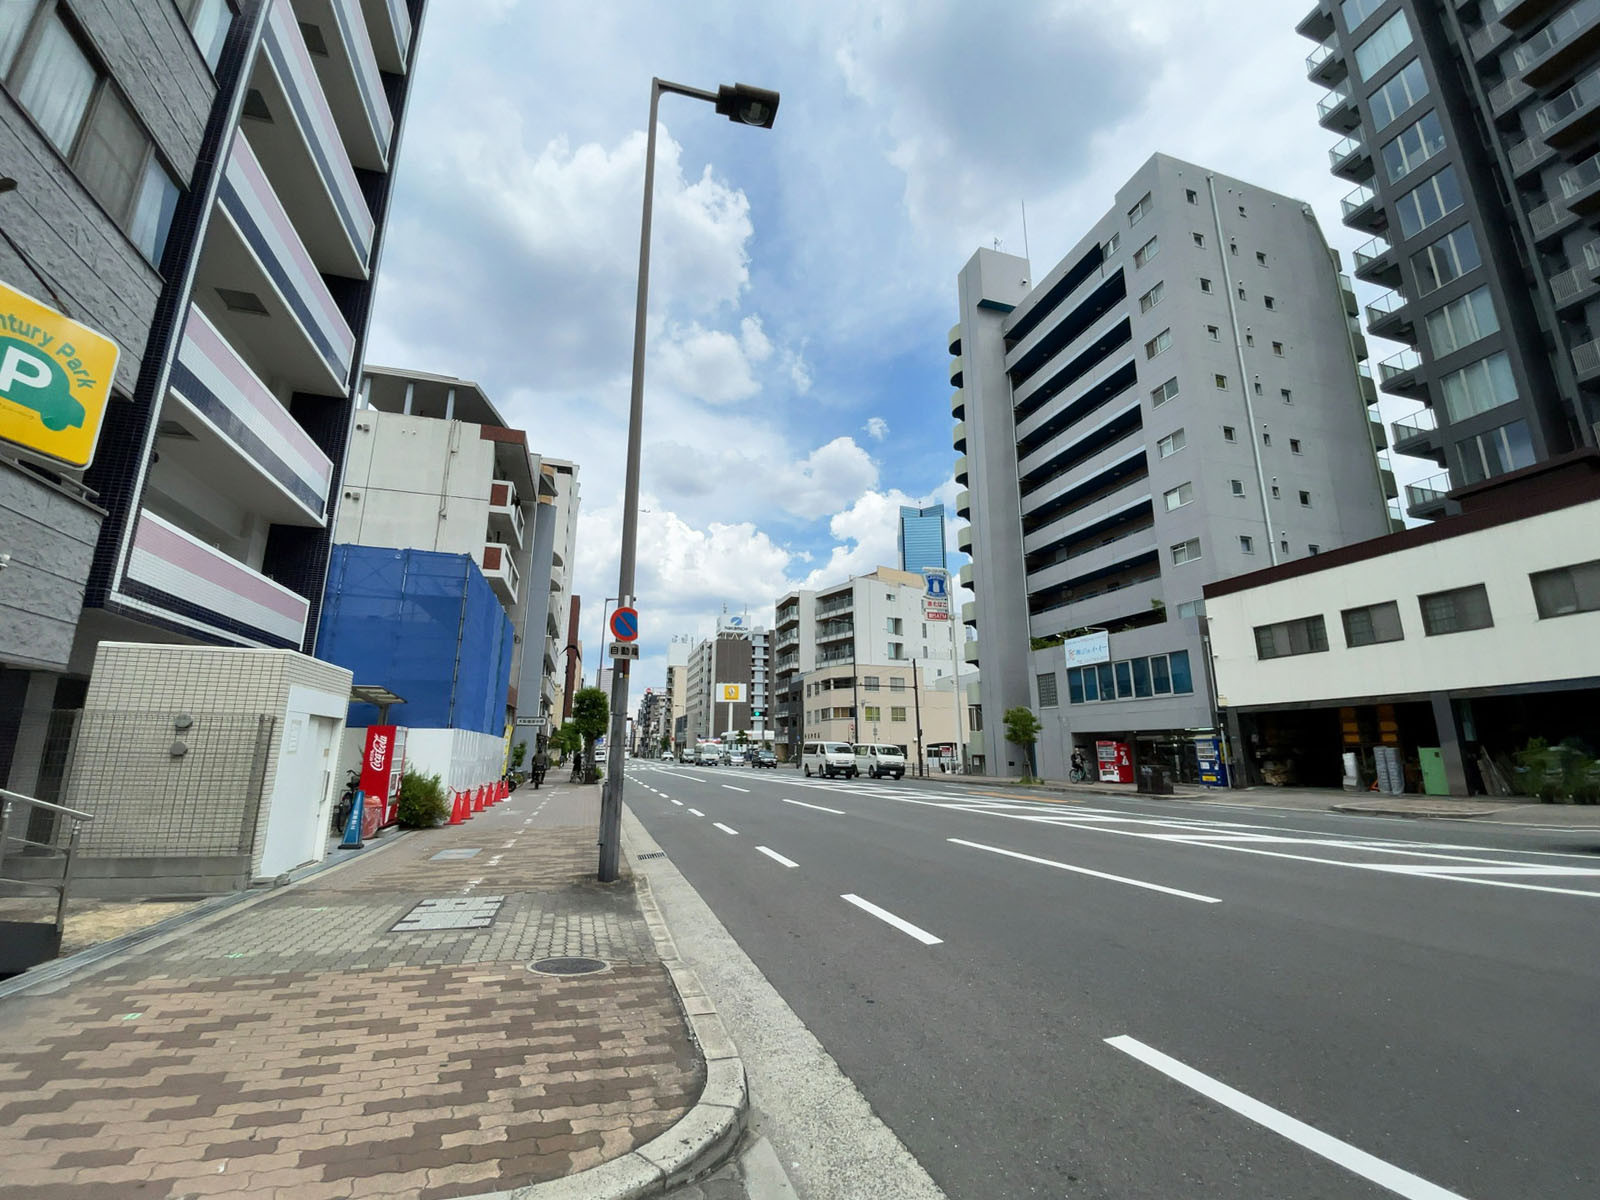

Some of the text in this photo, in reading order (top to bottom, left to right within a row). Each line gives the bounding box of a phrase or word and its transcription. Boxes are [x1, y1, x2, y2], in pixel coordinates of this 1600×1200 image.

[0, 345, 53, 393] P
[56, 342, 97, 389] Park
[370, 733, 388, 771] Coca-Cola
